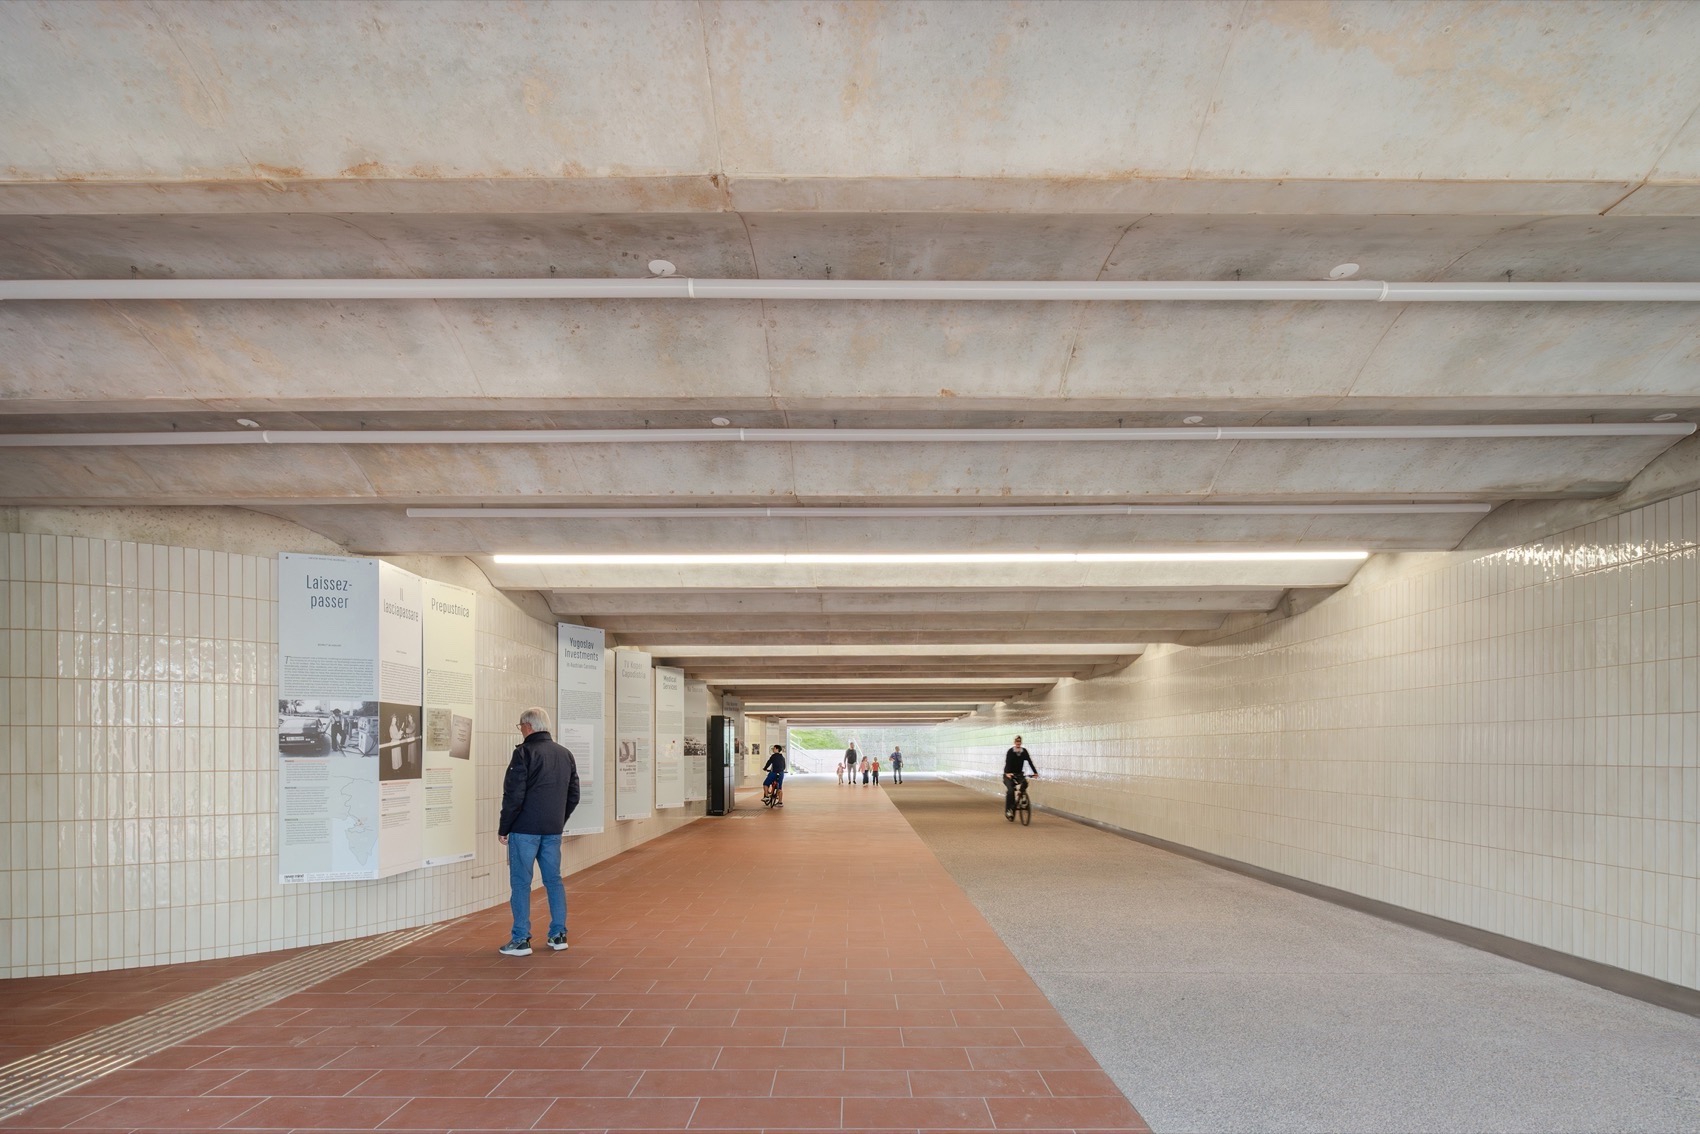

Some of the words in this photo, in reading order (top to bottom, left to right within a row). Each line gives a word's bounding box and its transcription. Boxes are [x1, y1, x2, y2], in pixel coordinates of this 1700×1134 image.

[306, 574, 352, 591] Laissez-
[310, 595, 349, 609] passer
[431, 597, 470, 618] Prepustnica
[383, 598, 419, 622] lasciapassare
[569, 637, 595, 650] Yugoslav
[564, 648, 599, 661] Investments
